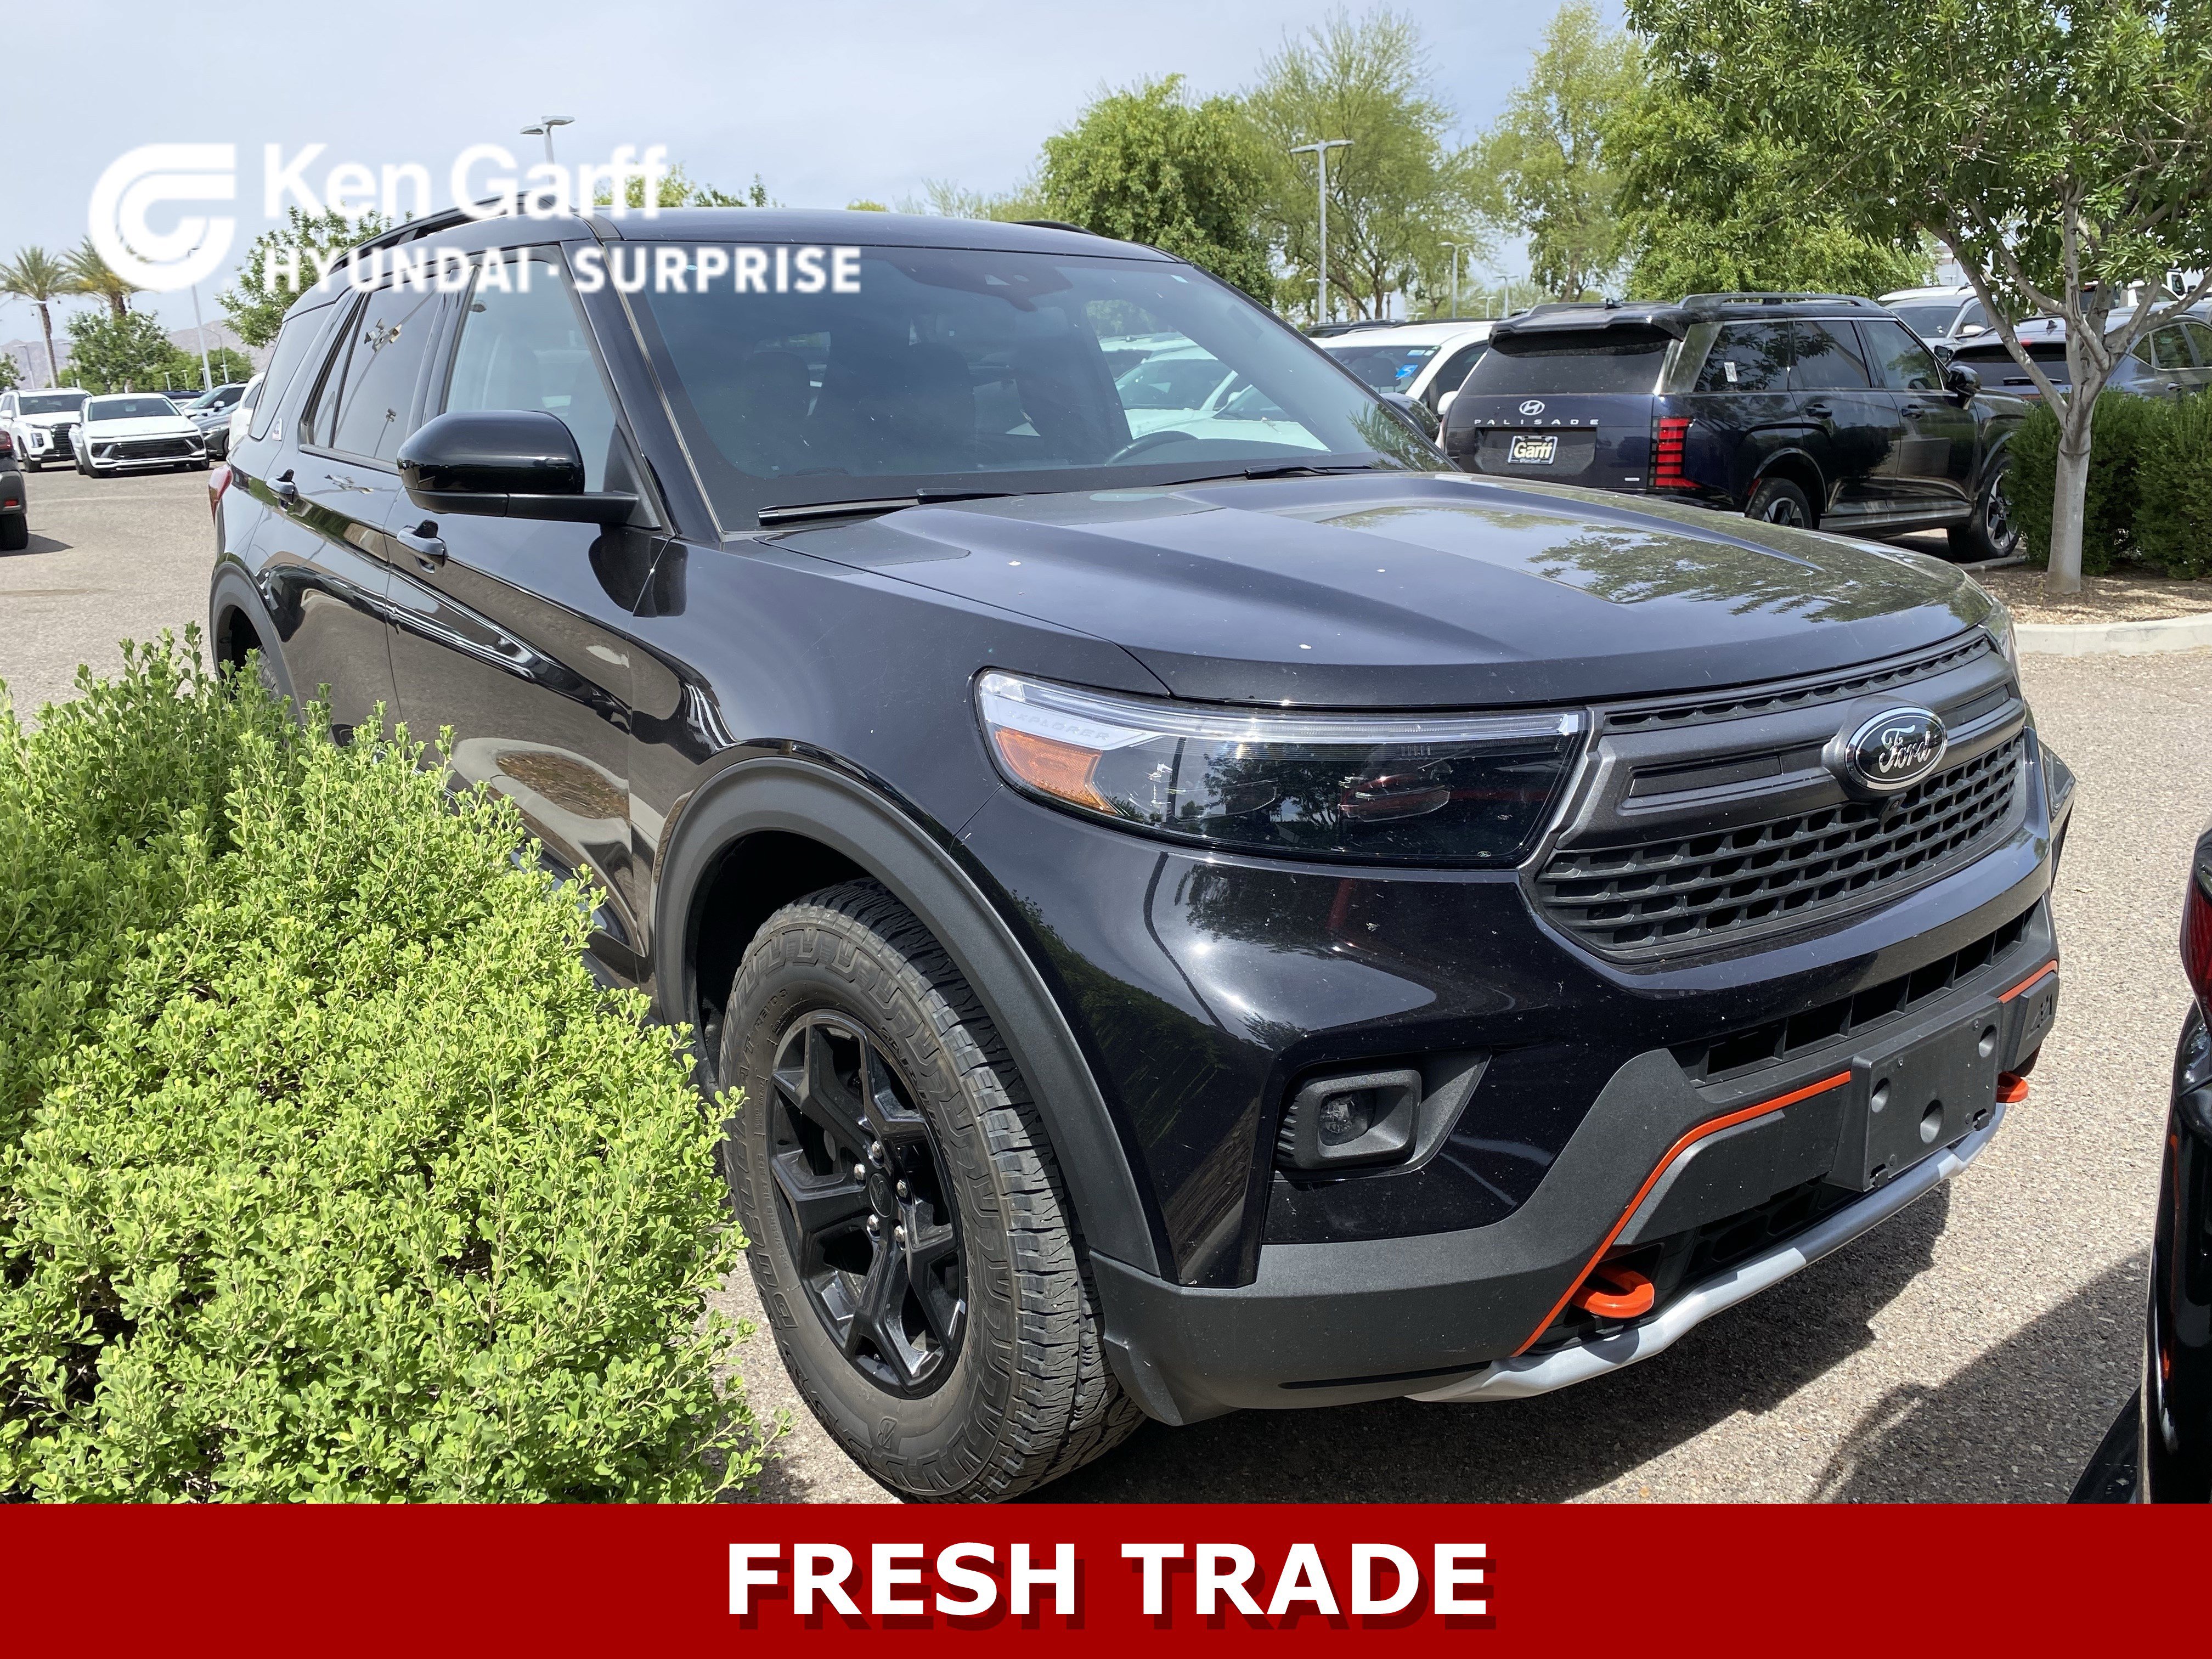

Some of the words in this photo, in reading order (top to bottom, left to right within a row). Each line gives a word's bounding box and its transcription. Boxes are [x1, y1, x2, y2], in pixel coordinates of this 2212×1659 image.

[1513, 441, 1553, 459] Garff
[1006, 710, 1110, 741] EXPLORER
[1878, 724, 1931, 774] Ford
[754, 995, 778, 1032] REVO
[778, 988, 788, 998] 3
